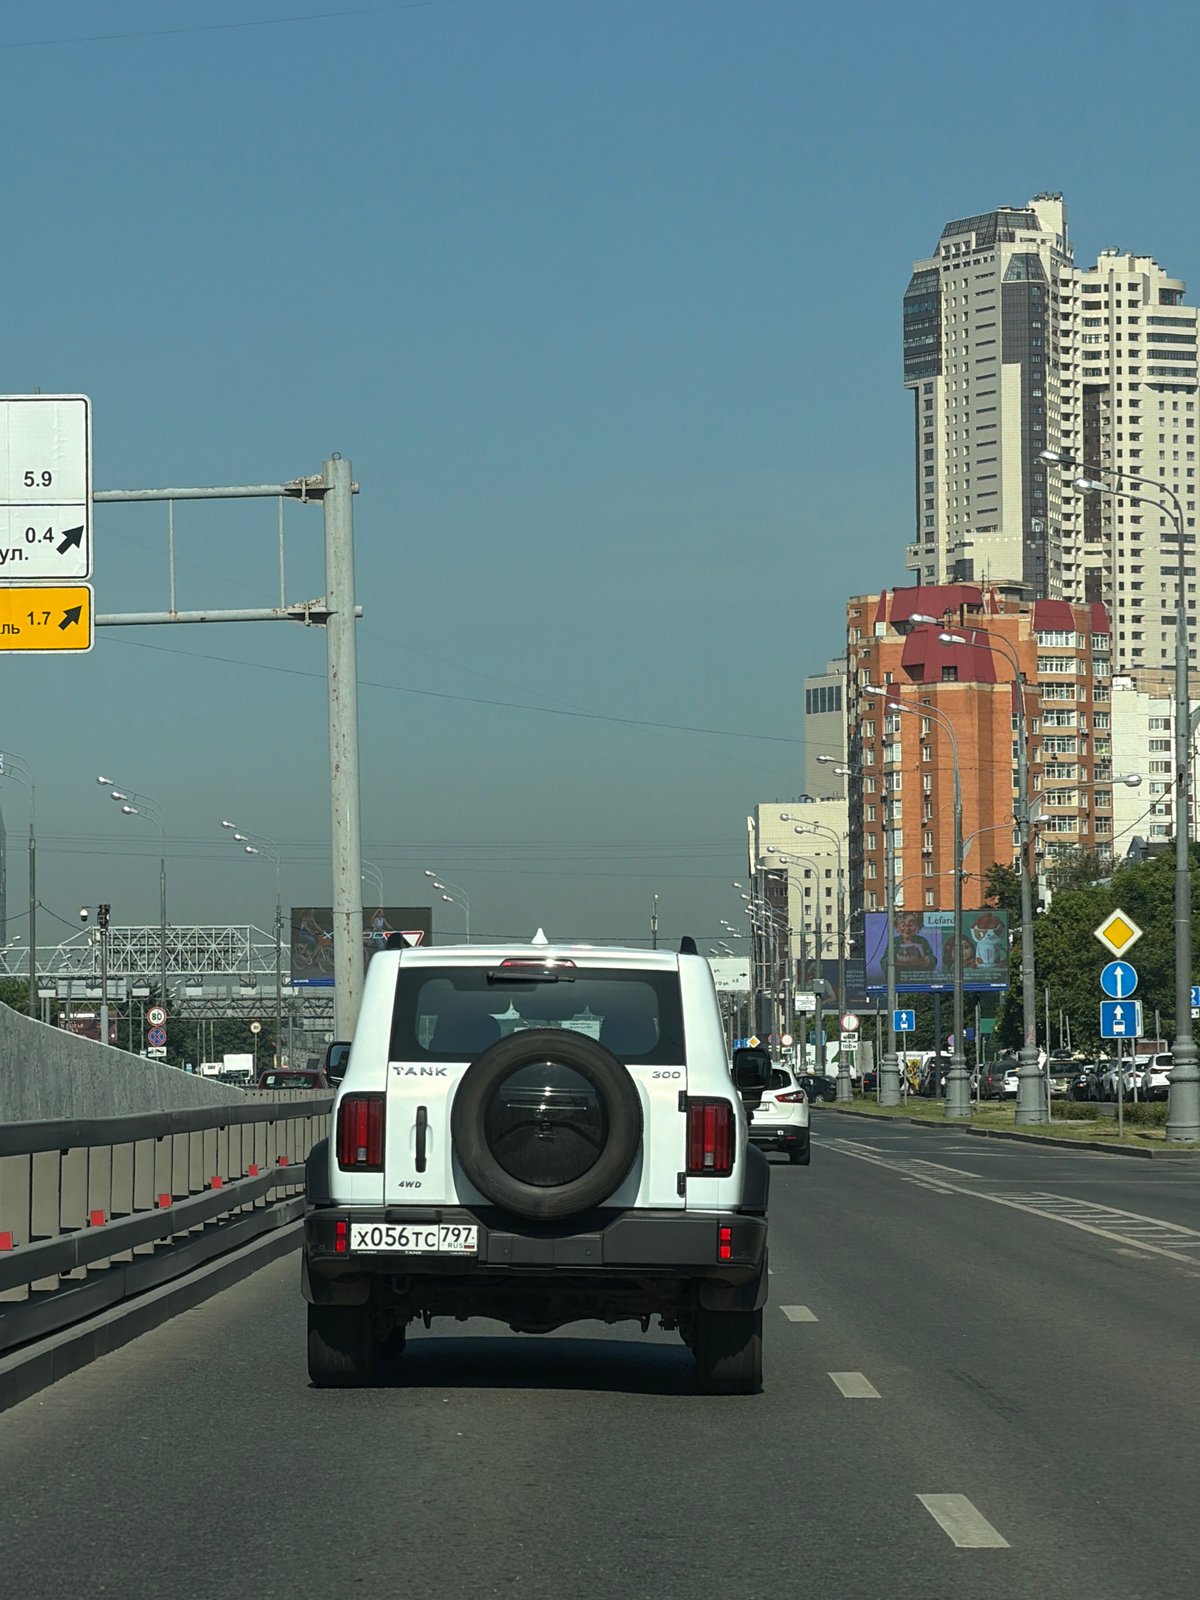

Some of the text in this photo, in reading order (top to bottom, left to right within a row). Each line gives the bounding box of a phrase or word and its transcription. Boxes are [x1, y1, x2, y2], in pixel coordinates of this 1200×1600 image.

[24, 470, 53, 488] 5.9
[25, 526, 54, 543] 0.4
[0, 548, 29, 565] ул.
[27, 611, 51, 625] 1.7
[151, 1012, 163, 1021] 80
[392, 1066, 448, 1077] TANK
[651, 1071, 681, 1079] 300
[398, 1180, 422, 1189] 4WD
[440, 1227, 472, 1243] 797
